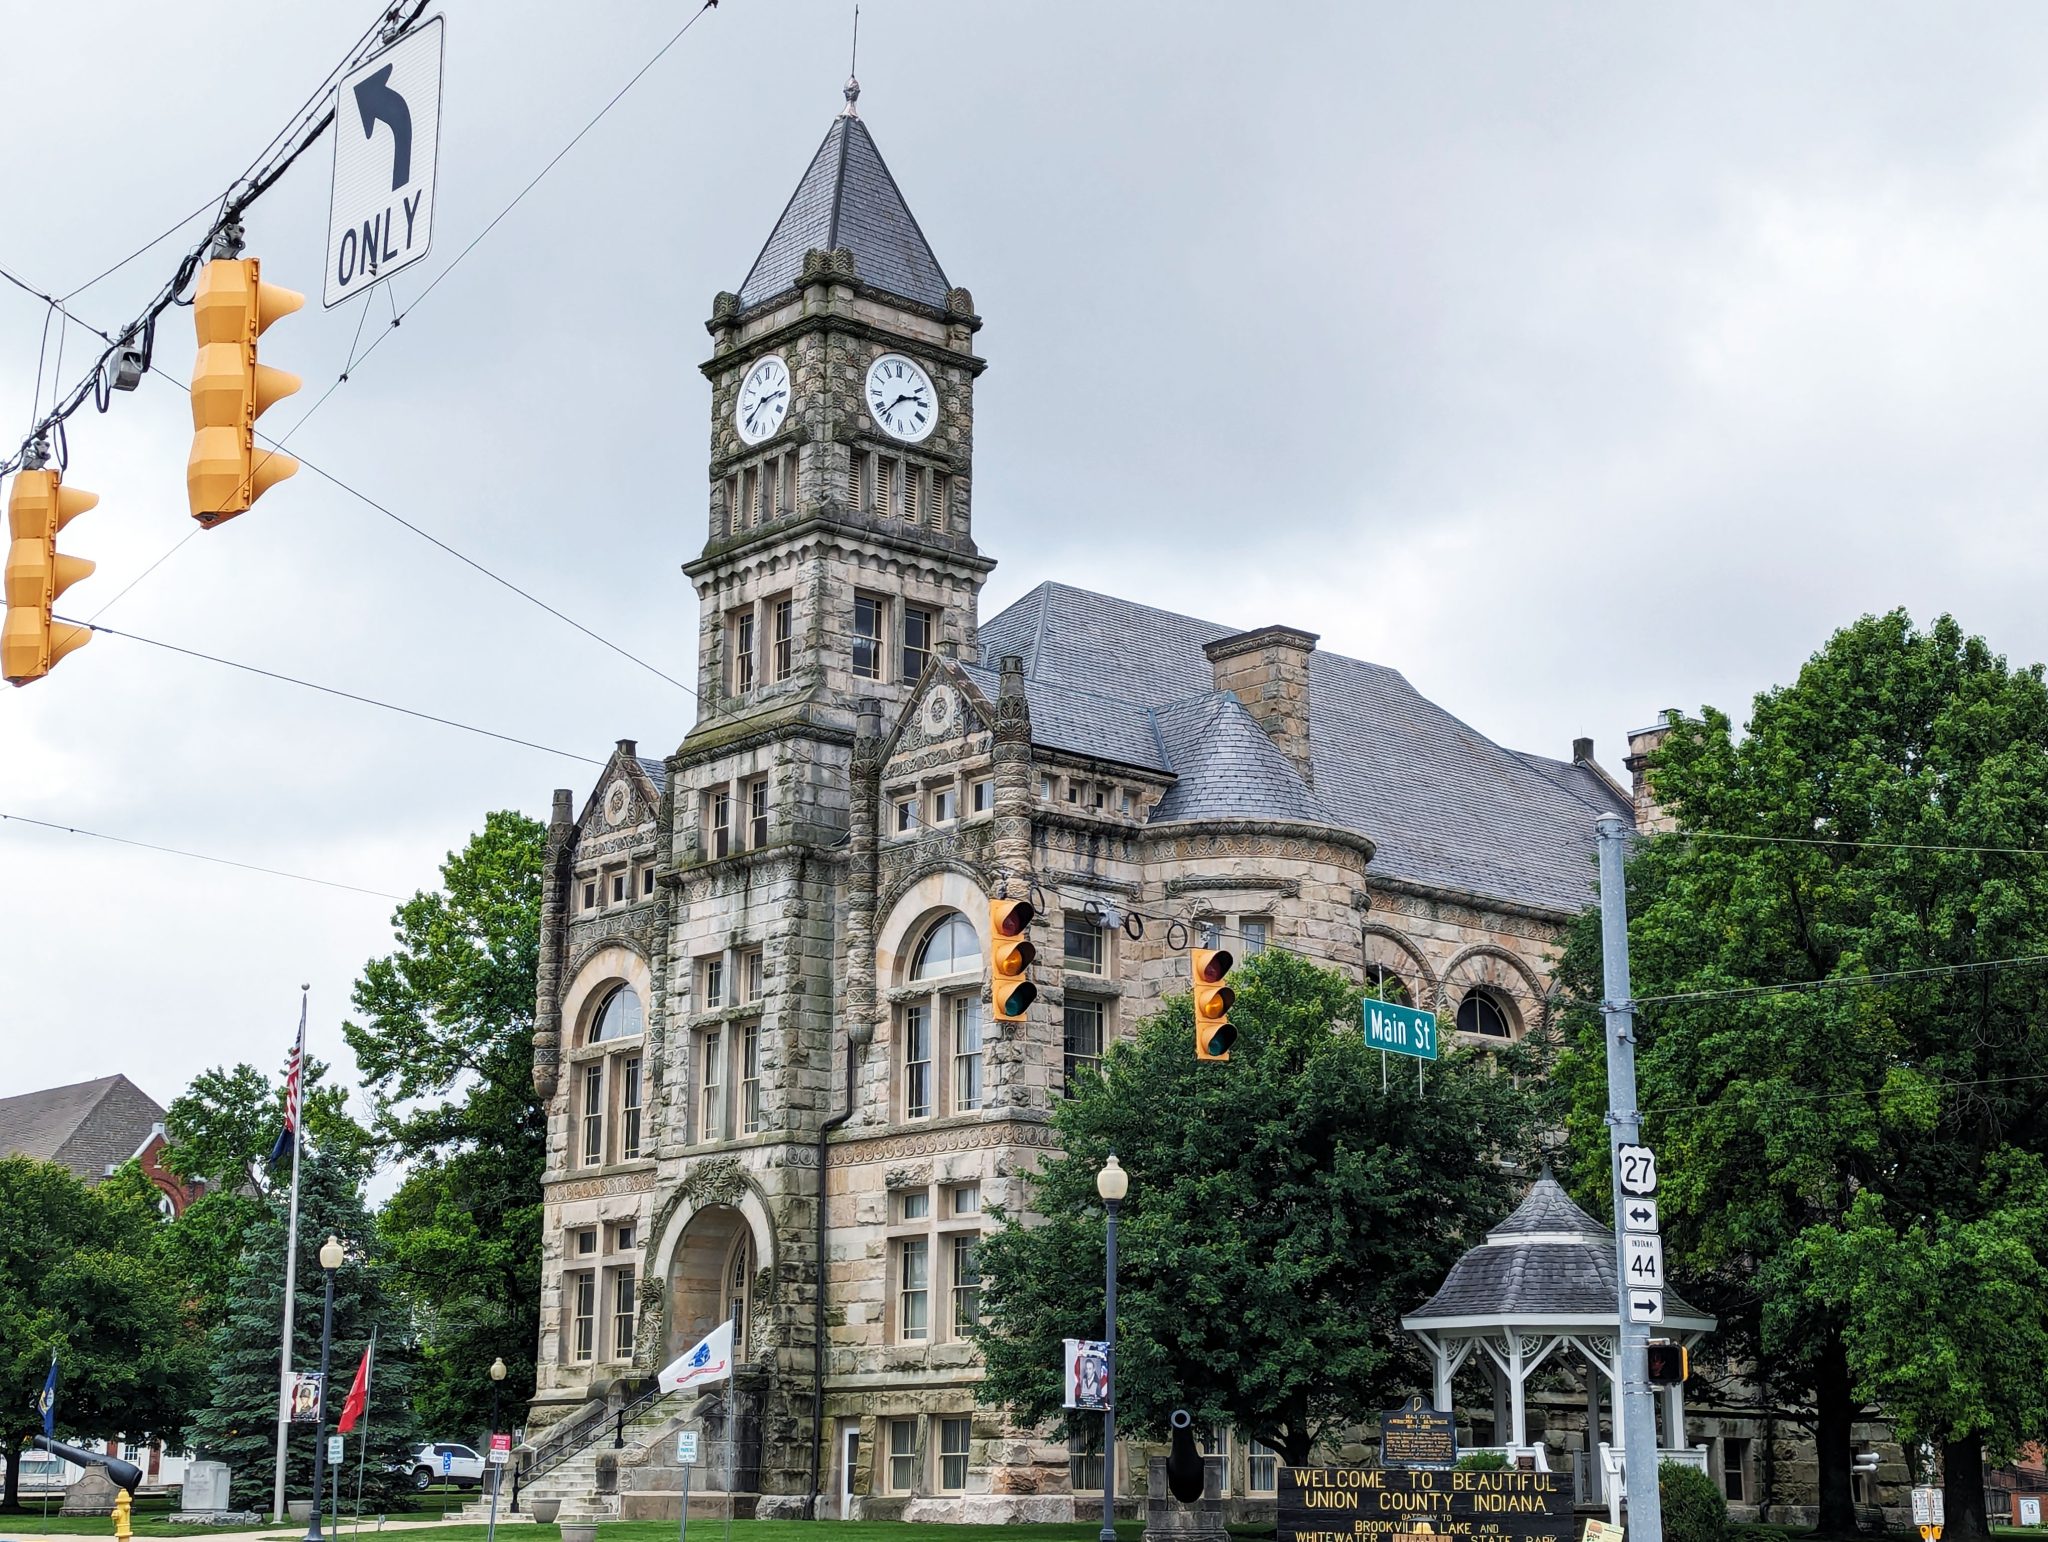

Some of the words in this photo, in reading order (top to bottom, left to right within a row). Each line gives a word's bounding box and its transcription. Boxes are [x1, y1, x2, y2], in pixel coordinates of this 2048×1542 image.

[338, 188, 422, 287] ONLY
[1371, 1008, 1406, 1046] Main
[1414, 1018, 1430, 1051] St
[1624, 1155, 1651, 1184] 27
[1631, 1239, 1654, 1249] INDIANA
[1631, 1254, 1656, 1278] 44
[1294, 1469, 1386, 1489] WELCOME
[1408, 1471, 1433, 1490] TO
[1453, 1472, 1557, 1492] BEAUTIFUL
[1305, 1490, 1358, 1509] UNION
[1379, 1492, 1454, 1511] COUNTY
[1474, 1494, 1547, 1512] INDIANA
[1355, 1520, 1418, 1534] BROOKVILL
[1440, 1522, 1472, 1535] LAKE
[1480, 1523, 1499, 1534] AND
[1442, 1513, 1453, 1522] TO
[1295, 1531, 1379, 1542] WHITEWATER
